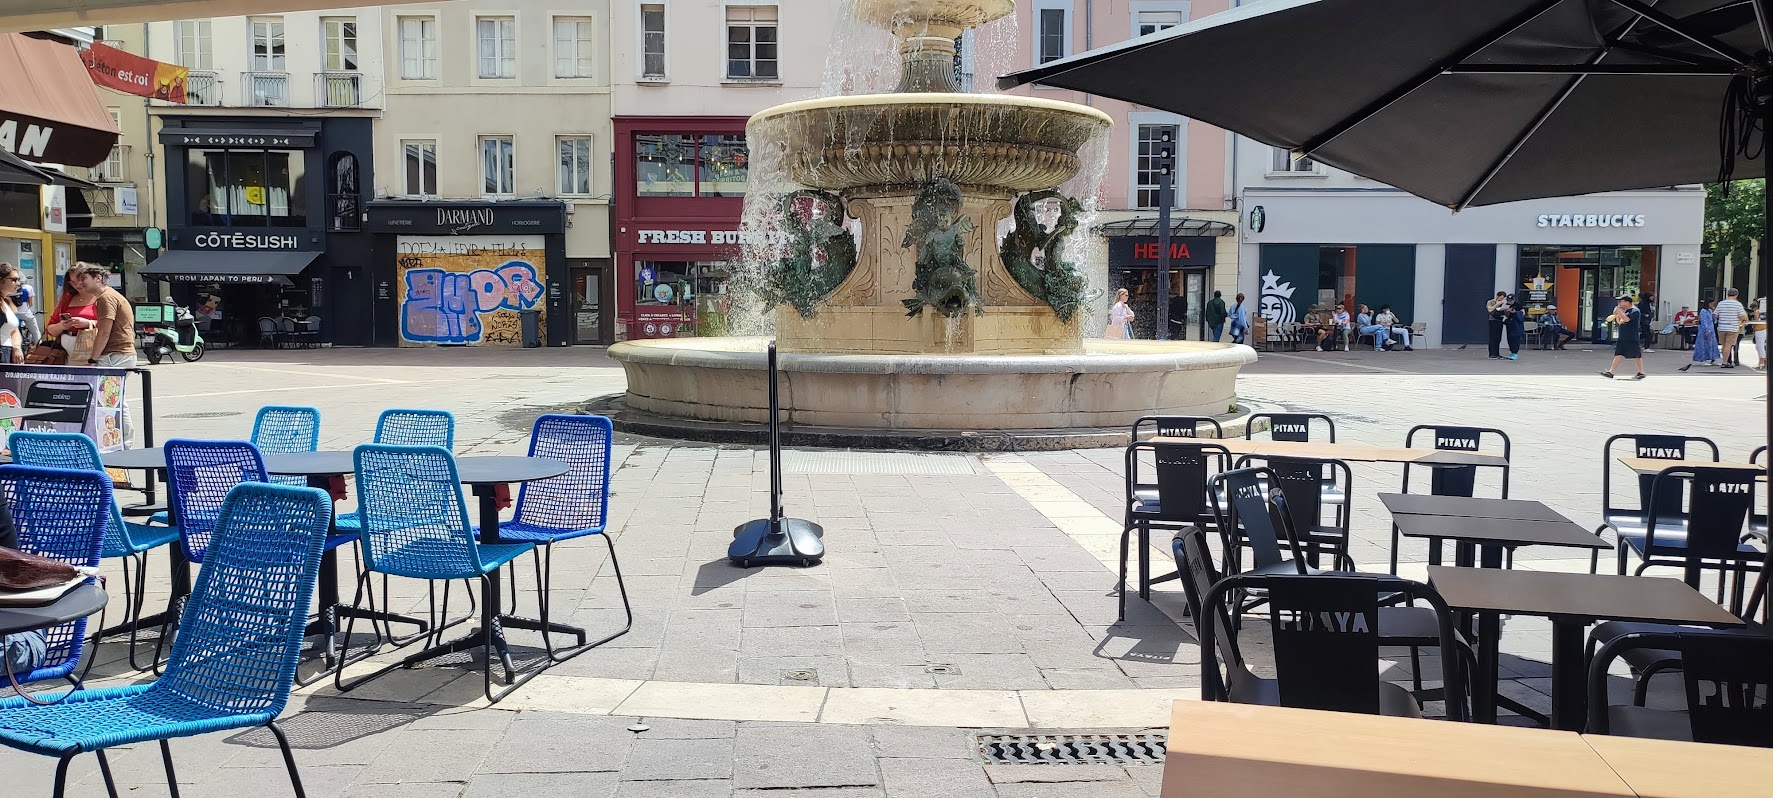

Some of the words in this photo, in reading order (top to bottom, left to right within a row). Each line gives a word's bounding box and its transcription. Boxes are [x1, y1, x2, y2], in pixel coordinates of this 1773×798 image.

[118, 69, 133, 83] est
[134, 73, 149, 86] roi
[437, 207, 494, 226] DARMAND
[1537, 214, 1645, 228] STARBUCKS
[637, 230, 707, 244] FRESH
[1160, 428, 1193, 437] PITAYA
[1273, 424, 1306, 433] PITAYA
[1437, 437, 1476, 449] PITAYA
[1639, 447, 1681, 458] PITAYA
